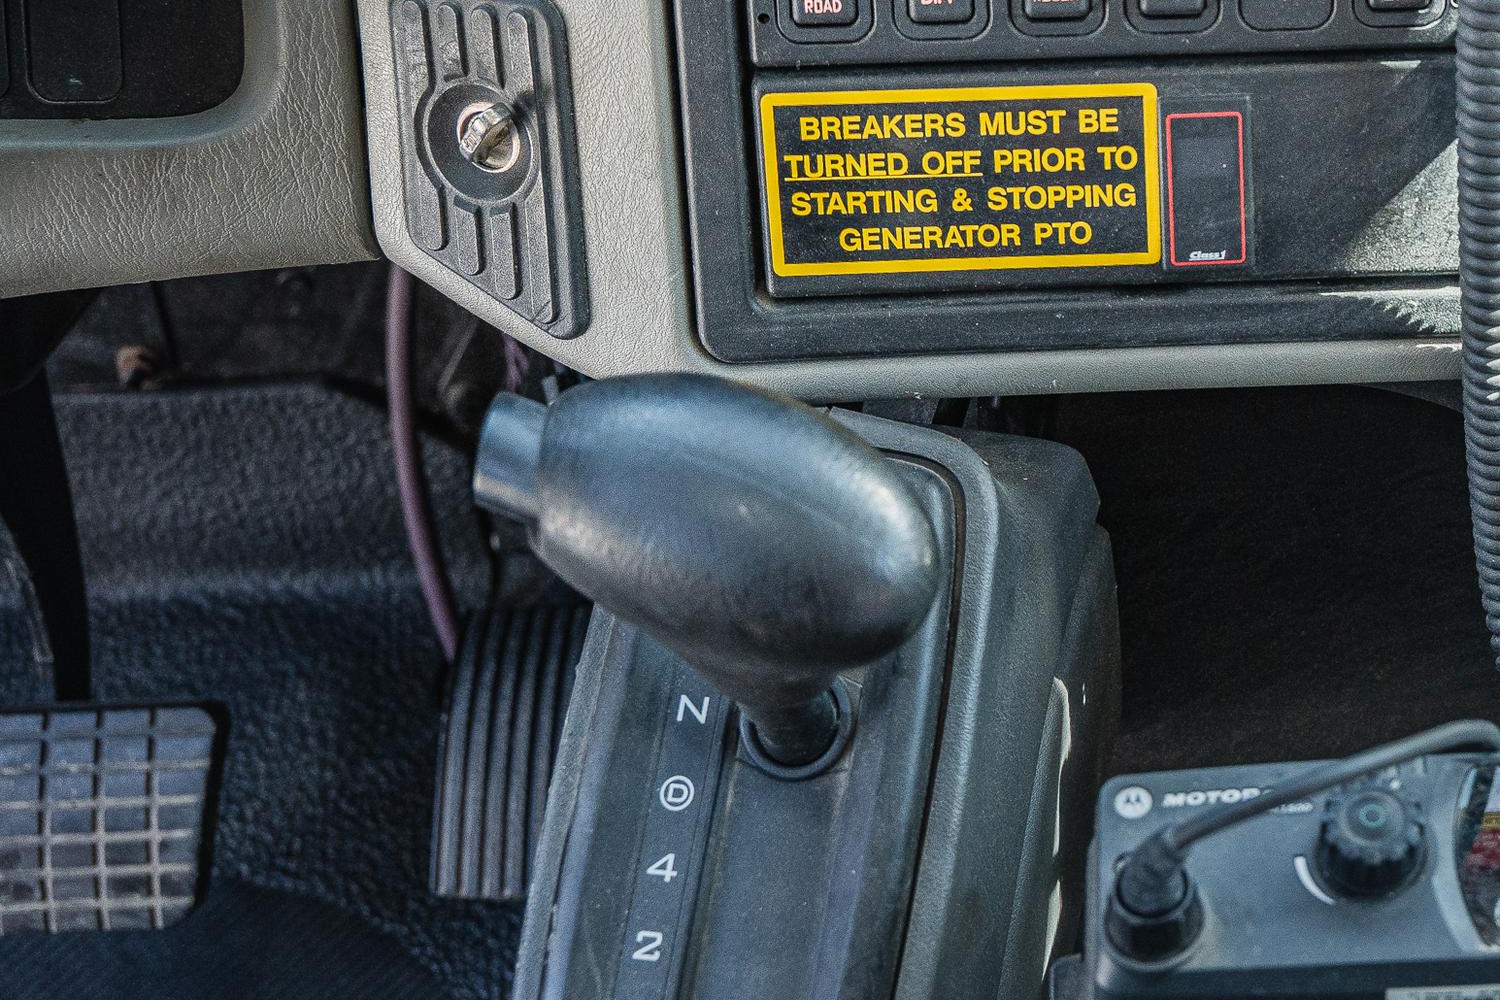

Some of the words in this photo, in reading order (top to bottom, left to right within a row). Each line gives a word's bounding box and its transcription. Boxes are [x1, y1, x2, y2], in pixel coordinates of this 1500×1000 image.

[799, 112, 966, 142] BREAKERS
[980, 109, 1066, 136] MUST
[1079, 108, 1119, 133] BE
[784, 152, 909, 179] TURNED
[922, 149, 981, 175] OFF
[994, 147, 1085, 174] PRIOR
[1097, 145, 1138, 170] TO
[791, 188, 938, 216] STARTING
[952, 187, 973, 211] &
[987, 183, 1137, 211] STOPPING
[839, 223, 1021, 252] GENERATOR
[1035, 220, 1093, 246] PTO
[677, 695, 710, 724] N
[646, 853, 677, 882] 4
[632, 930, 663, 961] 2
